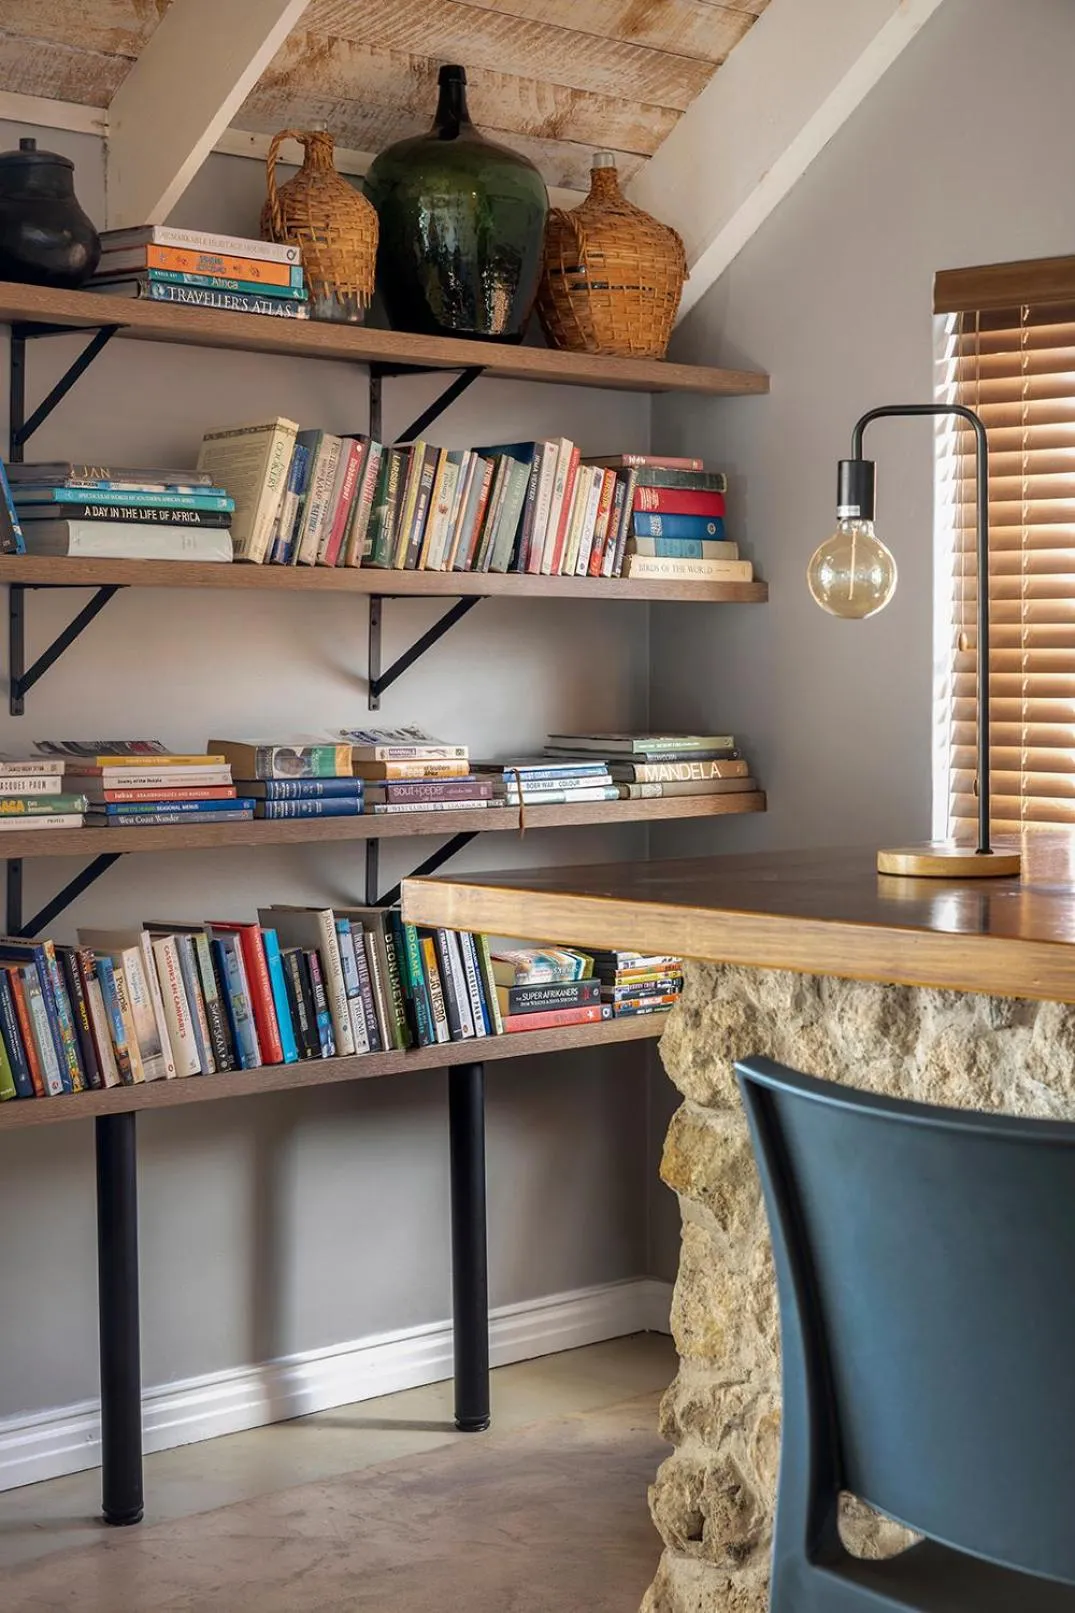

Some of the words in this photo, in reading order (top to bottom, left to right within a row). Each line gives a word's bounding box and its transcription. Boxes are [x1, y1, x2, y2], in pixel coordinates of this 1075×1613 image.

[211, 277, 238, 290] Africa
[167, 286, 249, 312] TRAVELLER'S
[251, 300, 292, 318] ATLAS
[83, 465, 111, 479] JAN
[266, 440, 285, 490] COOKERY
[388, 455, 400, 493] LARSSON
[528, 474, 537, 500] VENTER
[84, 508, 91, 516] A
[92, 508, 107, 517] DAY
[111, 508, 119, 517] IN
[121, 509, 138, 518] THE
[140, 510, 157, 521] LIFE
[159, 511, 170, 521] OF
[171, 512, 201, 523] AFRICA
[639, 564, 660, 572] BIRDS
[672, 565, 686, 573] THE
[687, 566, 713, 574] WORLD
[644, 761, 722, 781] MANDELA
[0, 781, 24, 790] ACQUES
[393, 785, 445, 799] sout+peper
[119, 815, 134, 825] West
[135, 816, 154, 824] Coast
[155, 814, 179, 823] Wander
[407, 924, 420, 976] NDGAME
[439, 931, 448, 954] FRANZ
[442, 955, 452, 975] MARX
[385, 934, 396, 971] DEON
[391, 978, 406, 1026] MEYER
[428, 978, 439, 990] JO
[467, 966, 477, 997] JACQUES
[164, 944, 176, 981] CASSPIRS
[172, 995, 186, 1038] CAMPARI'S
[522, 988, 579, 1001] SUPERAFRIKANERS
